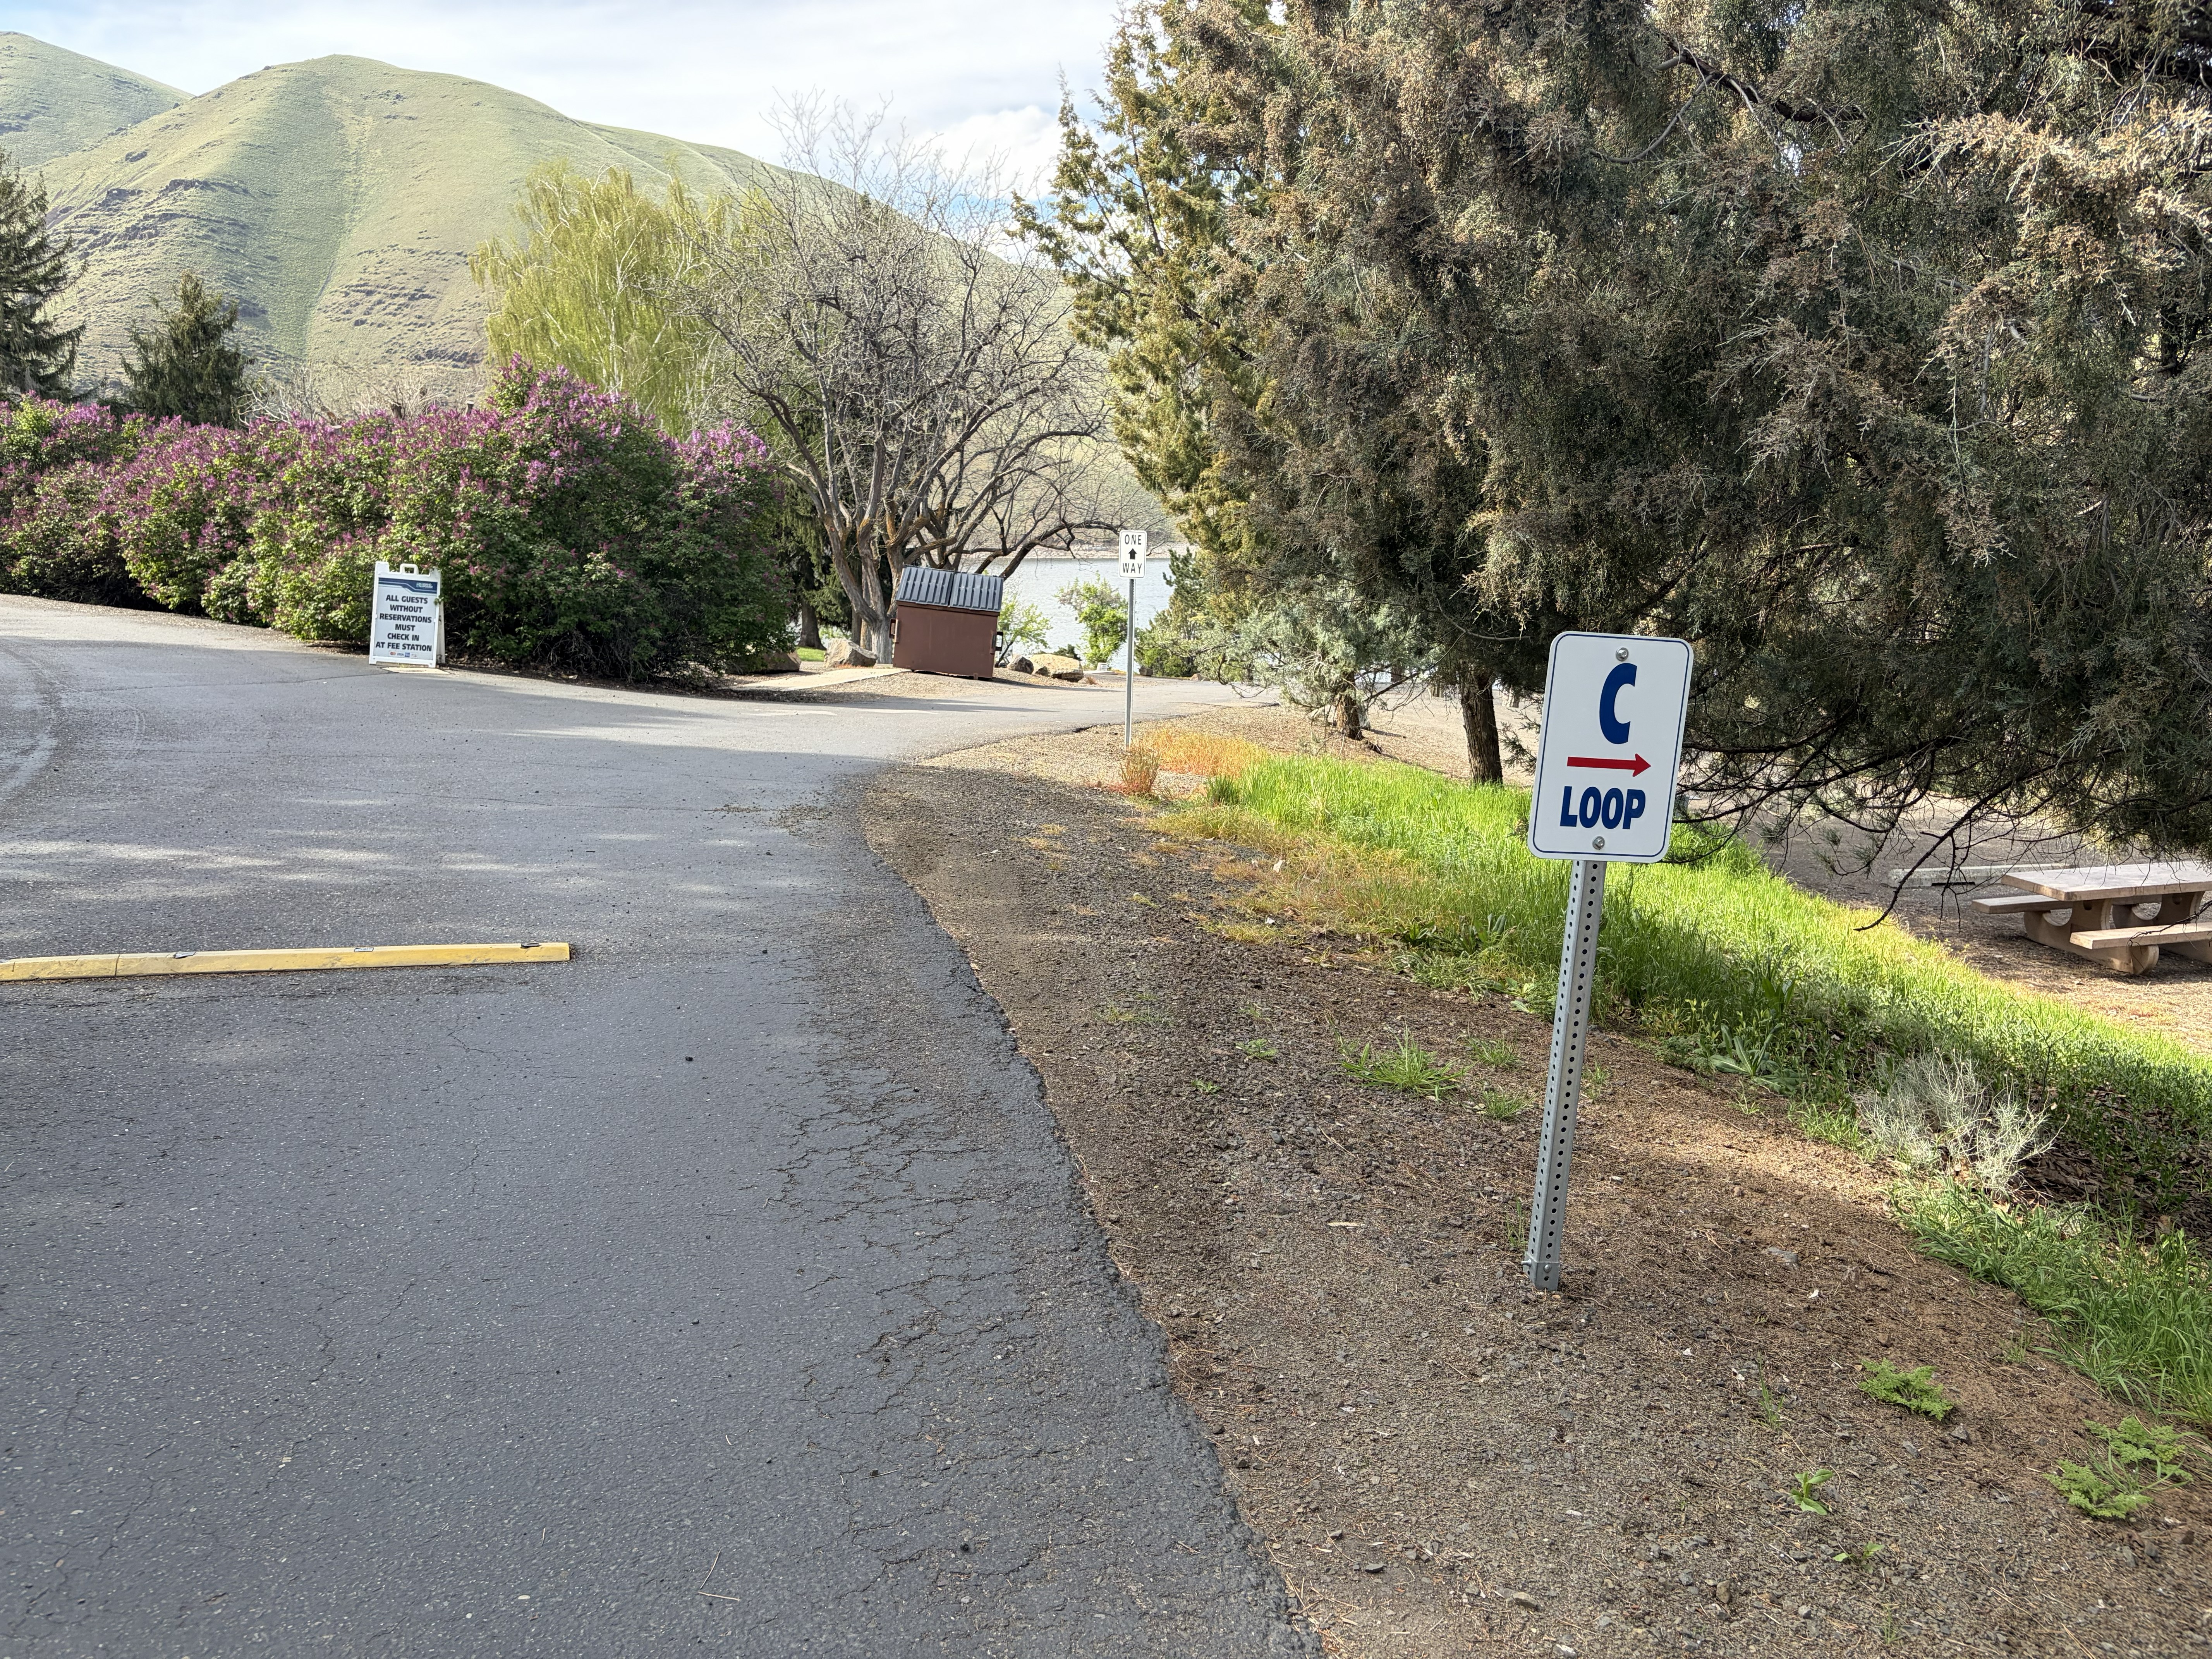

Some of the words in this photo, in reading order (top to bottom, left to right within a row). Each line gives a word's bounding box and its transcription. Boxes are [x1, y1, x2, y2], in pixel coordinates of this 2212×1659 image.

[1125, 534, 1142, 545] ONE
[1122, 563, 1142, 574] WAY
[402, 596, 428, 604] GUESTS
[390, 605, 423, 613] WITHOUT
[380, 613, 432, 623] RESERVATIONS
[1599, 663, 1637, 744] C
[1559, 786, 1646, 830] LOOP
